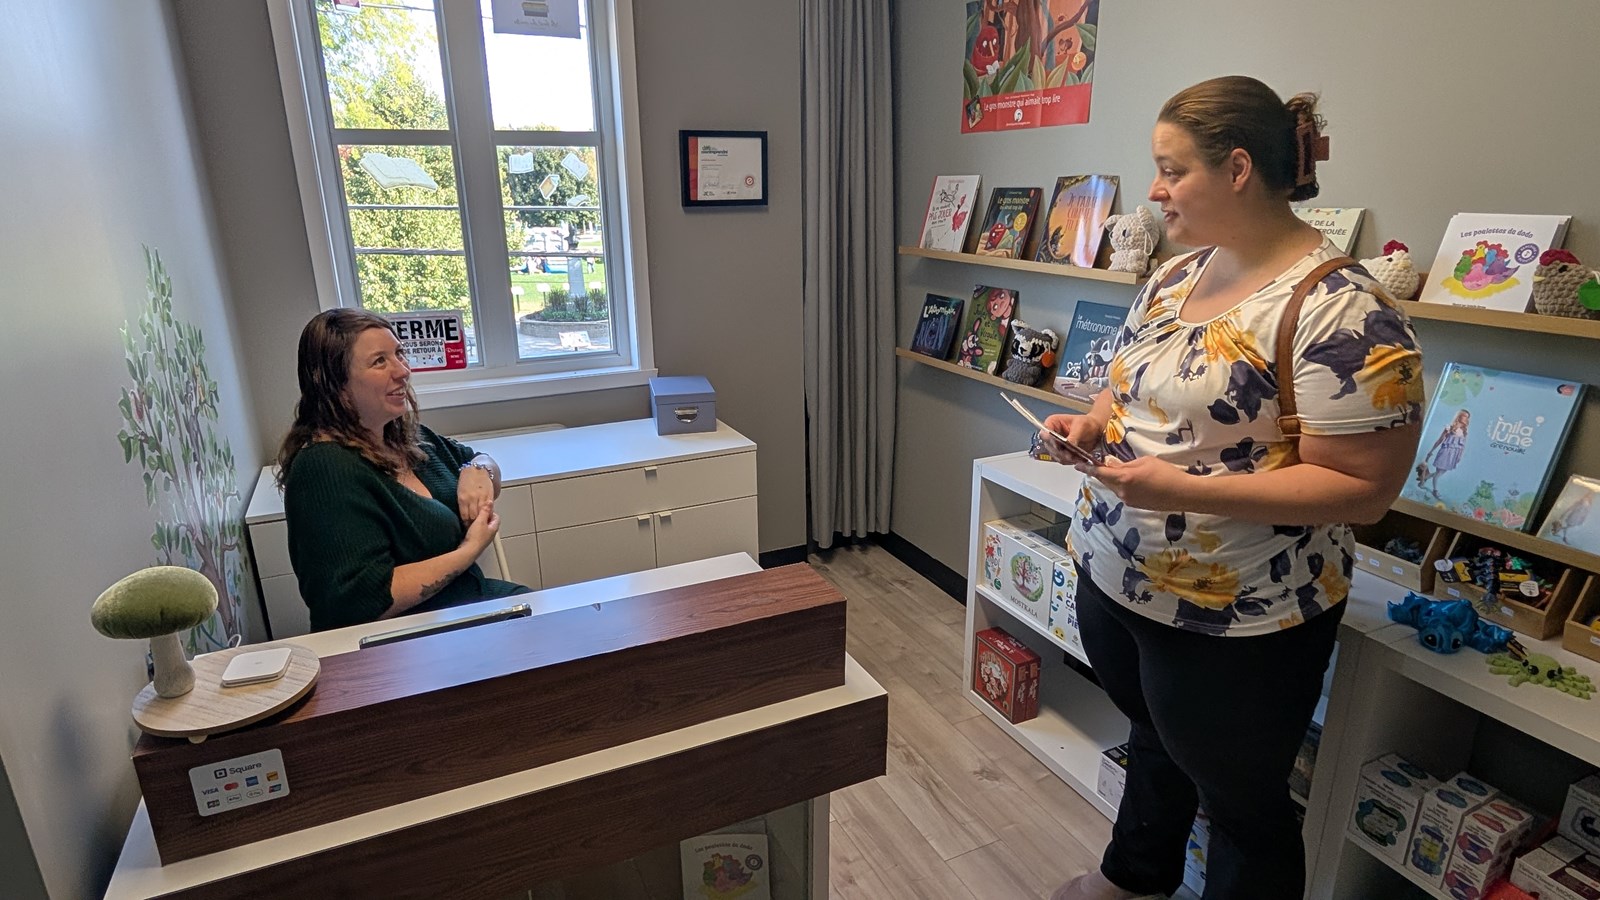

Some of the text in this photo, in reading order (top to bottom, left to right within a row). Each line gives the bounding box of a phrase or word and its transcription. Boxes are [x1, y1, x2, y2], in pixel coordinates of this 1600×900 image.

[997, 101, 1016, 109] monstre
[1017, 100, 1025, 109] qui
[1025, 98, 1041, 106] aimait
[1042, 96, 1051, 105] trop
[1052, 94, 1061, 103] lire
[1517, 230, 1534, 238] dodo
[390, 318, 458, 341] ERME
[1075, 319, 1118, 336] métronome
[412, 346, 437, 354] RETOUR
[1496, 420, 1533, 437] mila
[1491, 431, 1533, 447] lune
[1065, 600, 1076, 610] CA
[1067, 617, 1078, 630] PIE
[229, 762, 262, 775] Square
[202, 787, 219, 795] VISA
